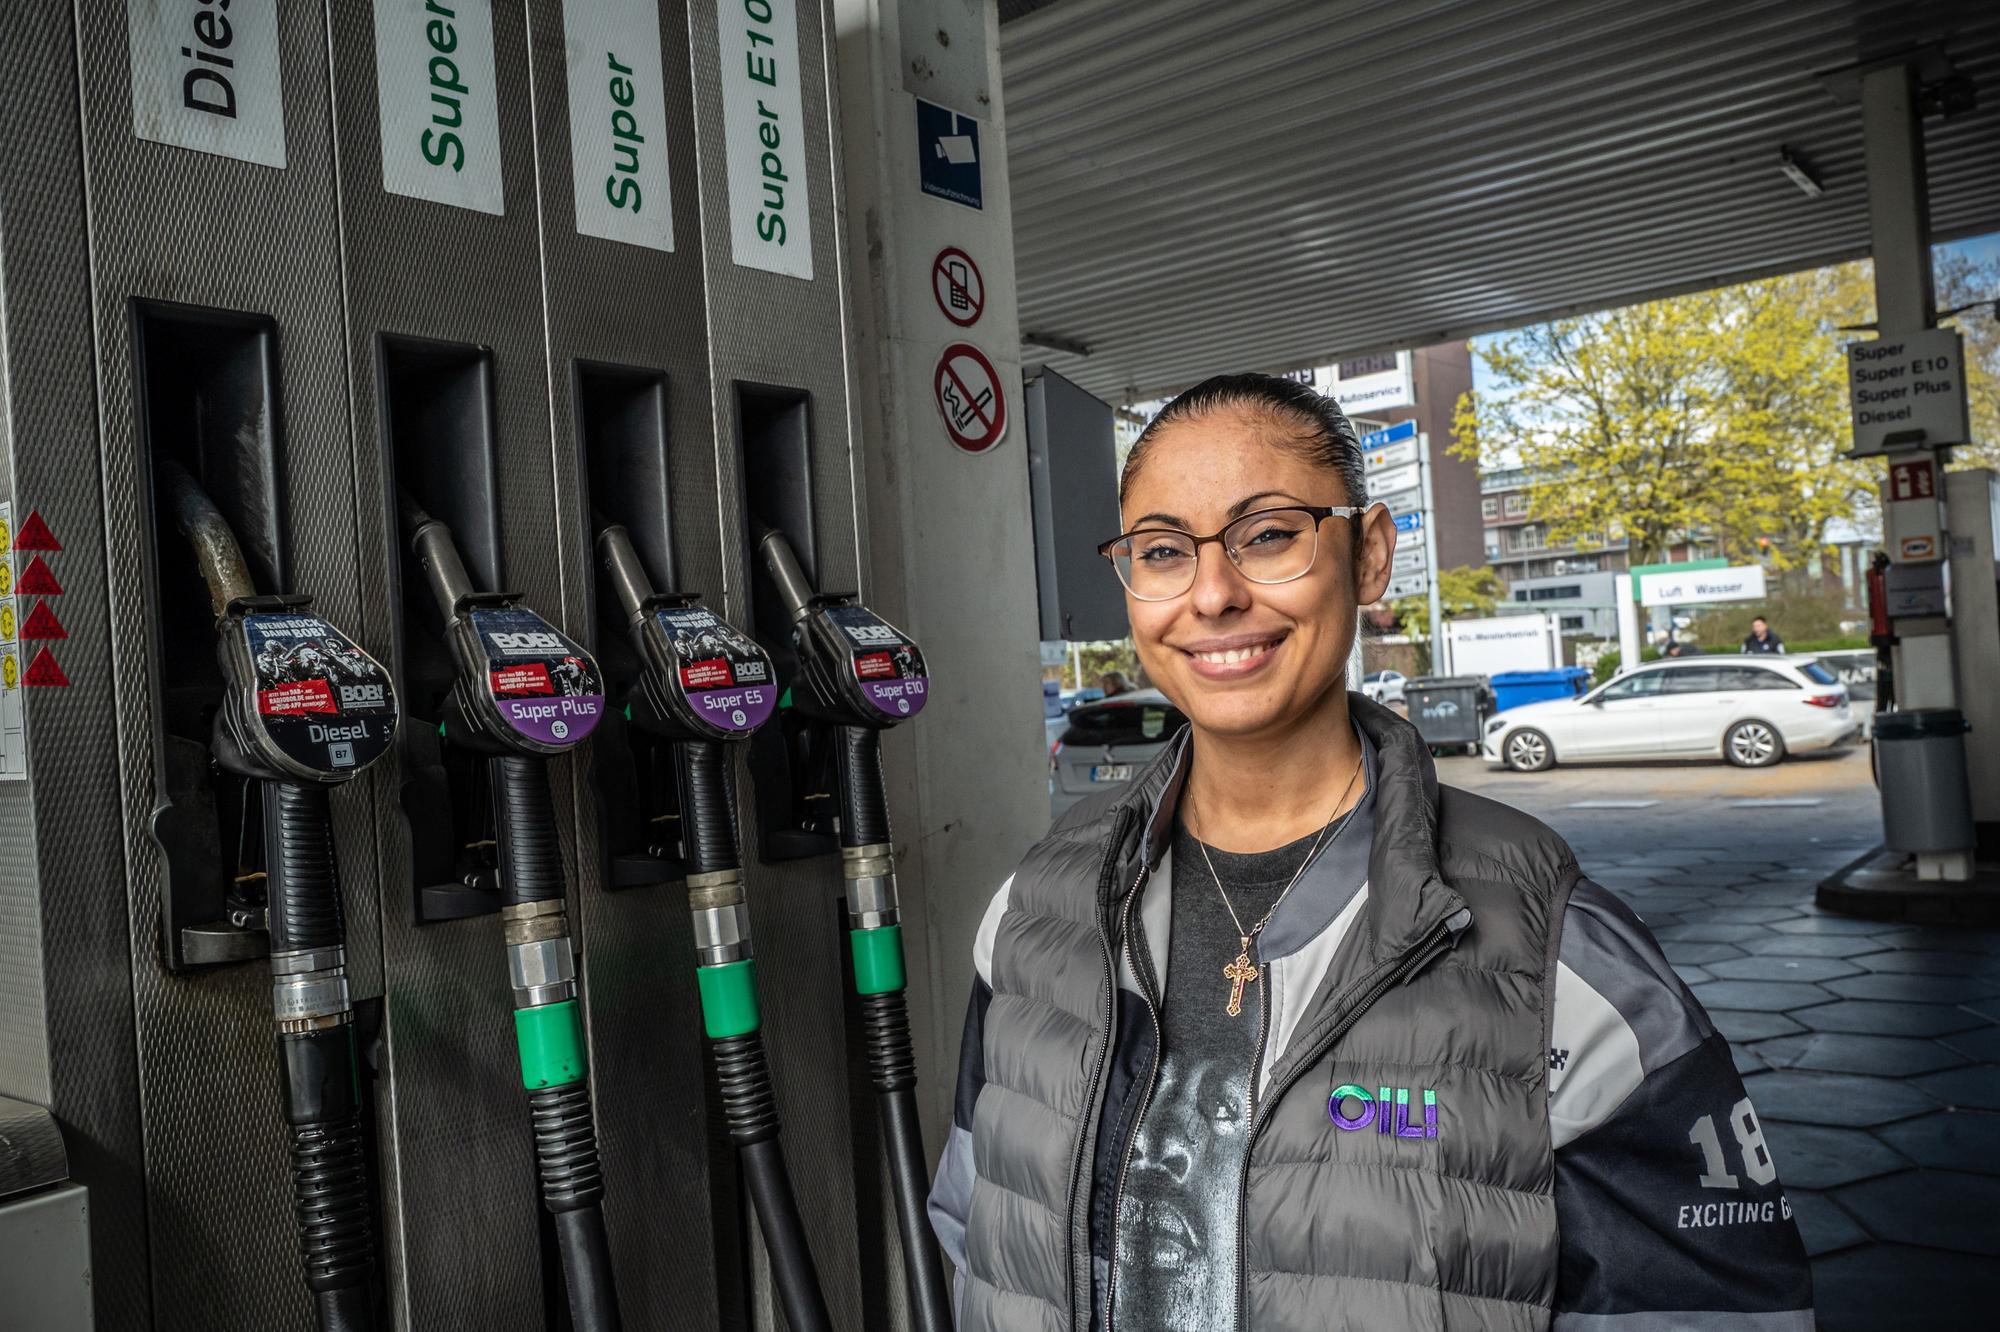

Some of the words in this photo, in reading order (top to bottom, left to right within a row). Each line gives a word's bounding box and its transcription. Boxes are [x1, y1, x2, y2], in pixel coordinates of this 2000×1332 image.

[744, 0, 777, 87] E10
[420, 0, 469, 173] Super
[606, 52, 645, 214] Super
[757, 99, 788, 247] Super
[1854, 343, 1905, 362] Super
[1855, 366, 1907, 384] Super
[1911, 356, 1949, 374] E10
[1340, 385, 1402, 403] Autoservice
[1857, 386, 1908, 404] Super
[1914, 380, 1952, 396] Plus
[1859, 405, 1912, 425] Diesel
[1659, 585, 1682, 598] Luft
[1695, 583, 1742, 594] Wasser
[291, 627, 327, 638] BOB!
[489, 632, 564, 648] BOB!
[844, 625, 897, 640] BOB!
[735, 661, 765, 677] BOB!
[340, 683, 384, 702] BOB!
[704, 694, 742, 712] Super
[745, 690, 763, 704] E5
[873, 684, 903, 701] Super
[905, 680, 924, 695] E10
[511, 703, 558, 723] Super
[561, 700, 597, 717] Plus
[308, 720, 370, 743] Diesel
[554, 725, 565, 734] E5
[335, 750, 347, 759] B7
[1688, 1096, 1777, 1189] 18
[1678, 1200, 1774, 1229] EXCITING
